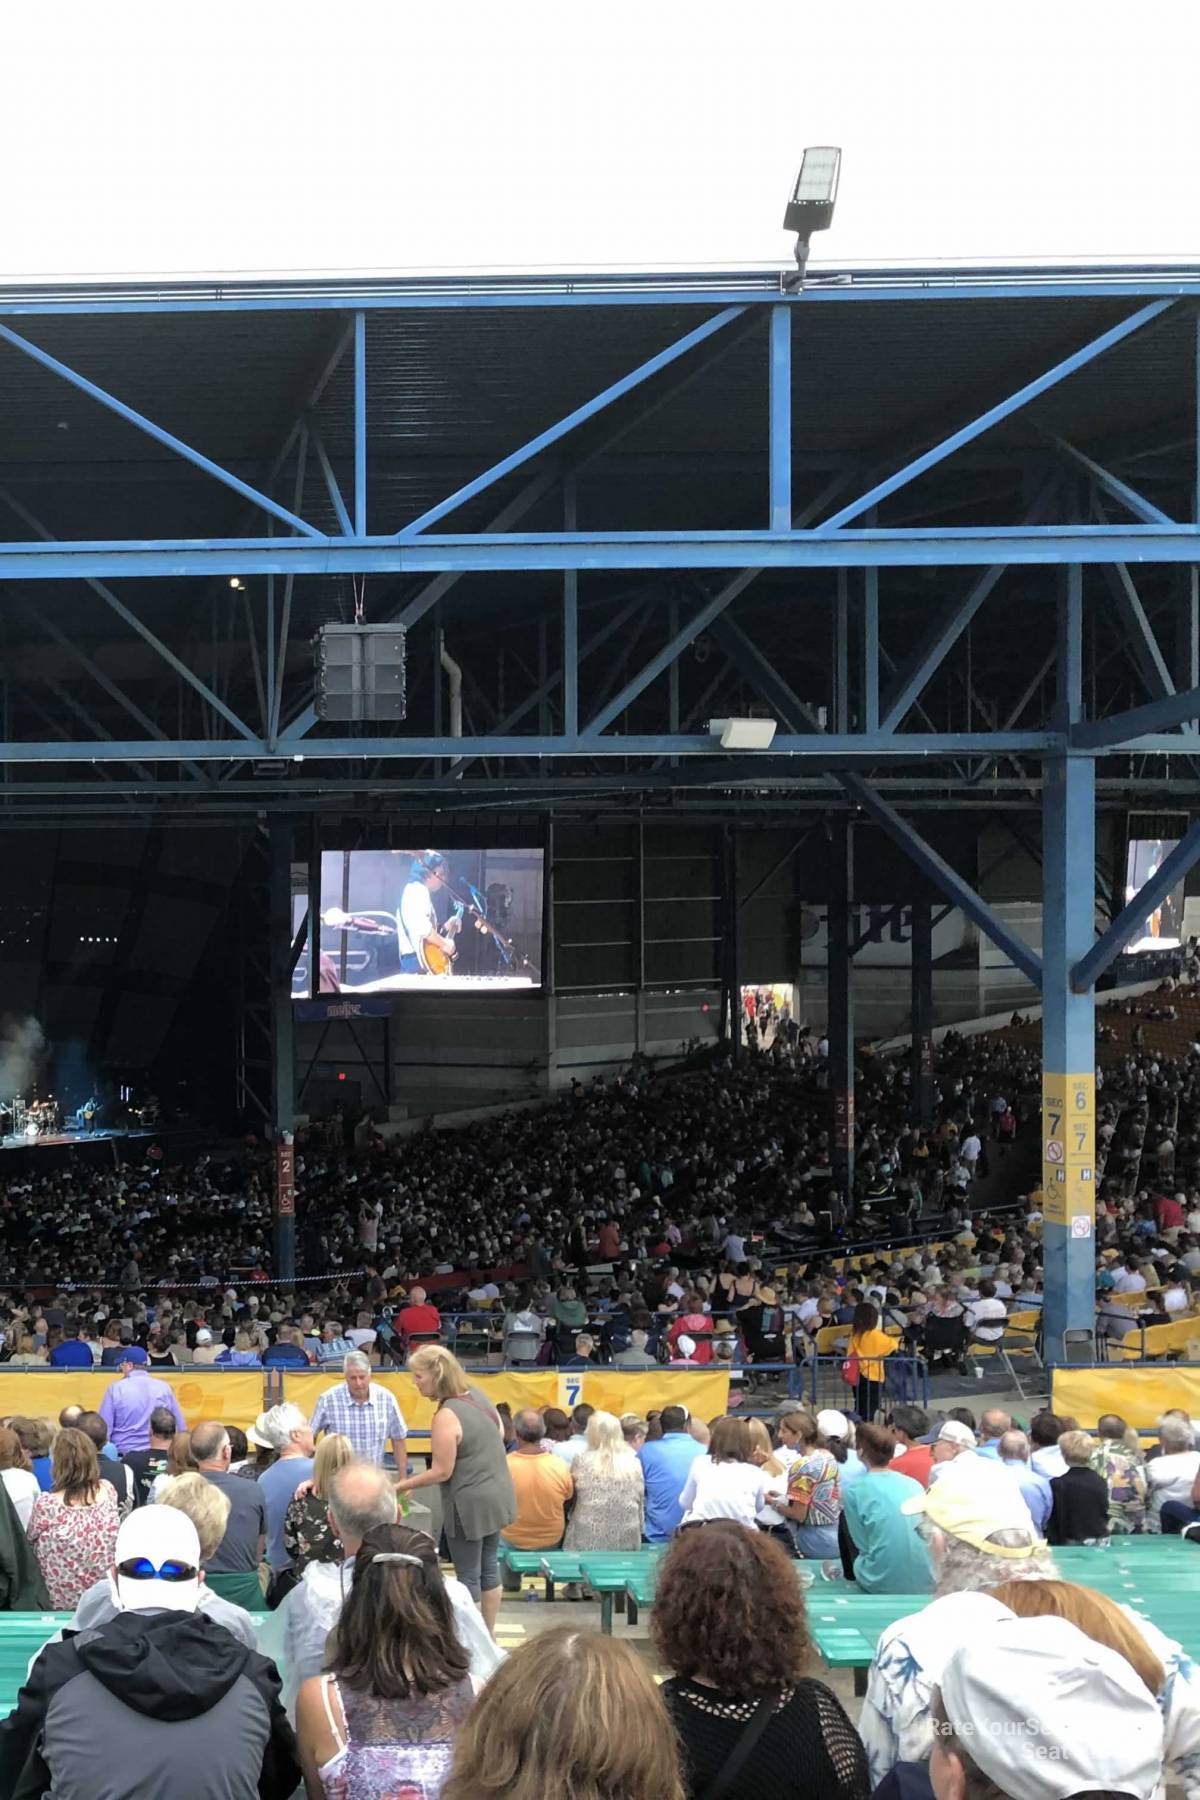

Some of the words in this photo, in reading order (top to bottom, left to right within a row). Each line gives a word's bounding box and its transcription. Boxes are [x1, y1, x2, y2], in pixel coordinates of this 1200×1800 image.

[1075, 1092, 1086, 1110] 6
[1047, 1113, 1061, 1135] 7
[1075, 1133, 1086, 1151] 7
[282, 1160, 290, 1172] 2
[566, 1385, 580, 1406] 7
